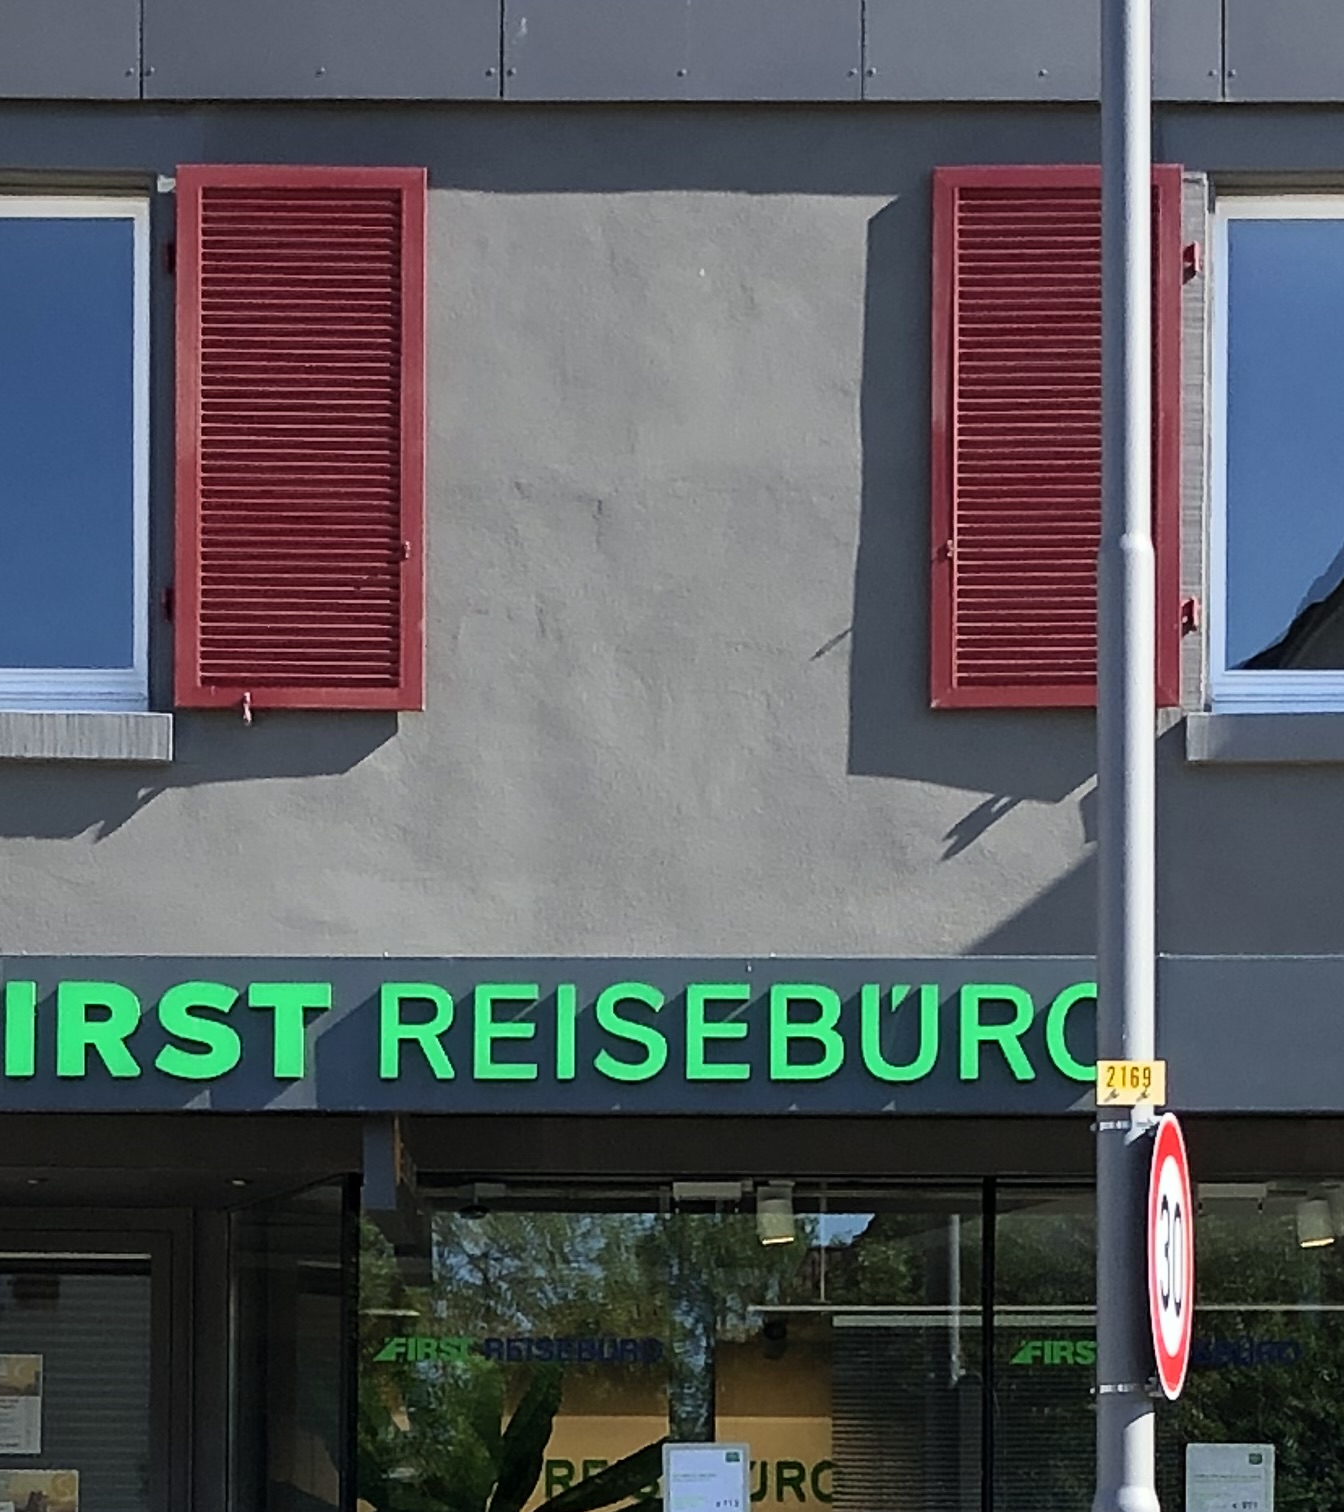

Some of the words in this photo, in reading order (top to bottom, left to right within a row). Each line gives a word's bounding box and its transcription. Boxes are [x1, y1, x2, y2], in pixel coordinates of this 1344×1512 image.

[1107, 1066, 1152, 1089] 2169
[1160, 1194, 1183, 1318] 30
[372, 1336, 474, 1362] FIRST
